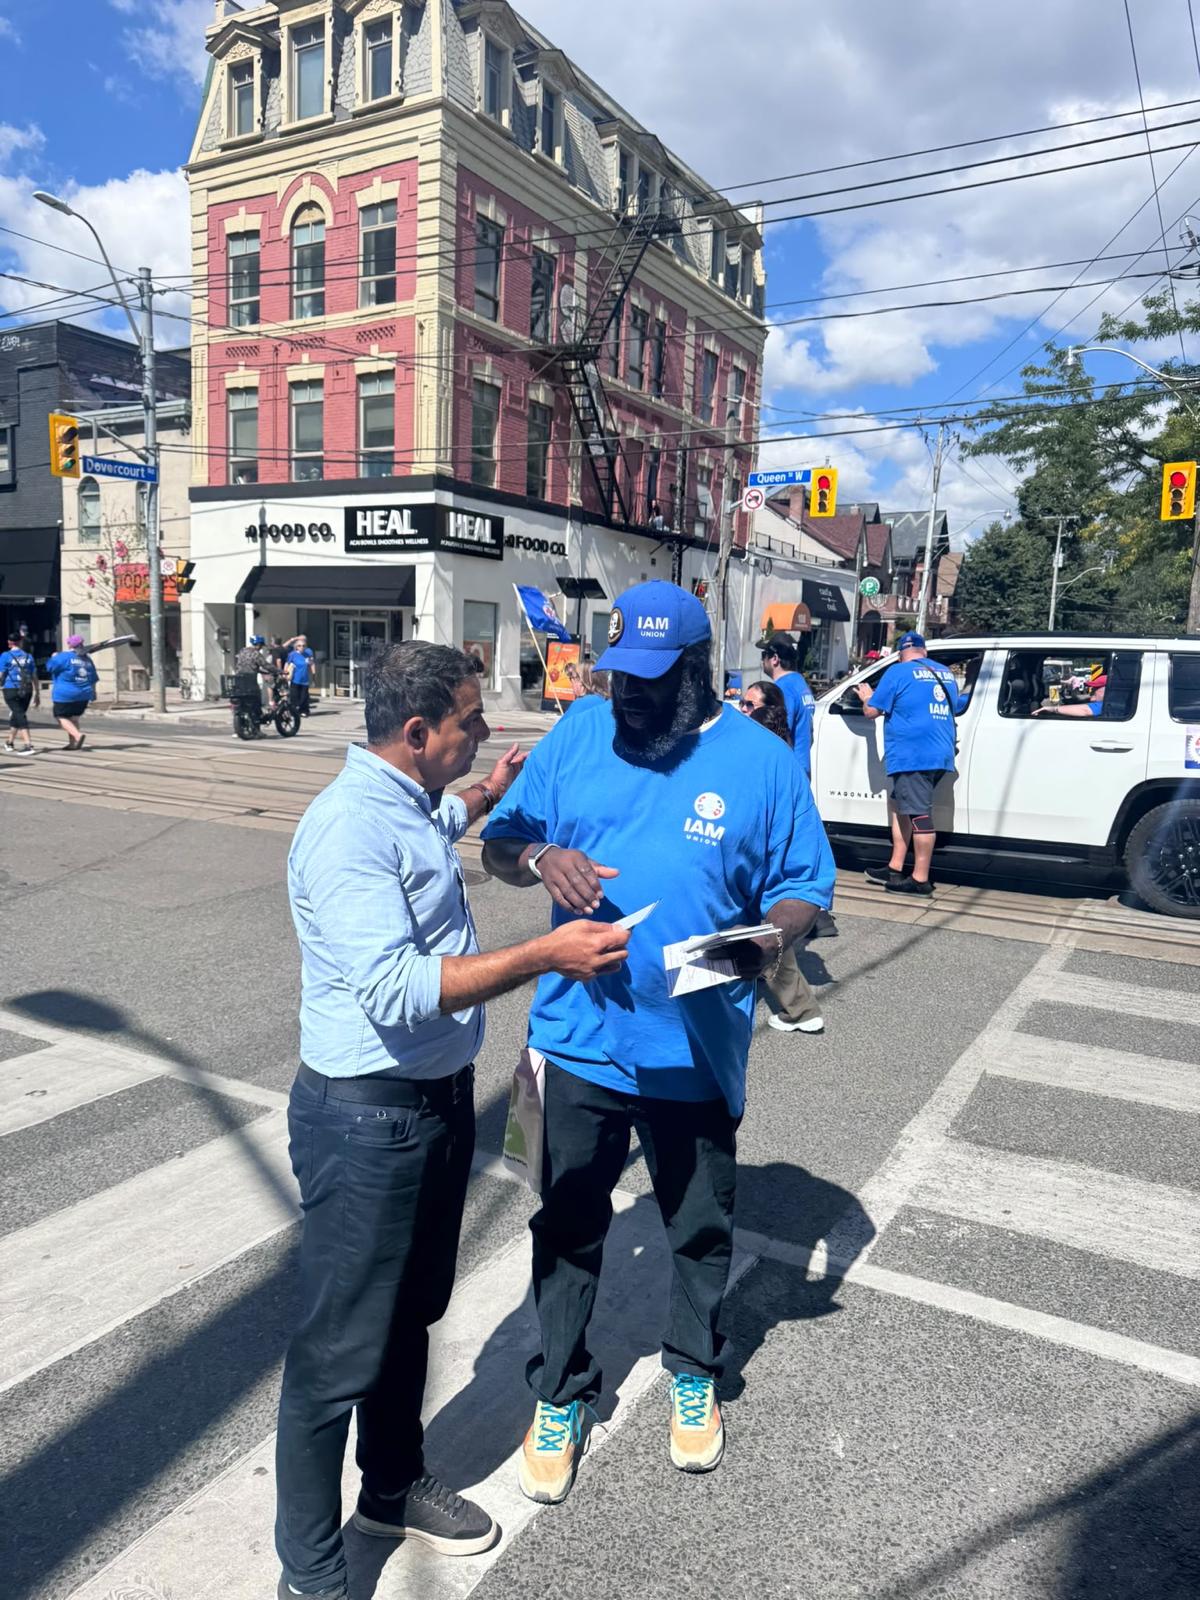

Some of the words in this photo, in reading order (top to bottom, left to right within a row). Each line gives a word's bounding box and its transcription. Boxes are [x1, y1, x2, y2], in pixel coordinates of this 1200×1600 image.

[86, 458, 145, 478] Dovercourt
[757, 473, 786, 484] Queen
[795, 471, 803, 481] W
[259, 523, 304, 539] FOOD
[449, 511, 496, 544] HEAL
[516, 535, 549, 553] FOOD
[637, 615, 669, 630] IAM
[640, 630, 665, 638] UNION
[929, 702, 950, 716] IAM
[683, 817, 726, 841] IAM
[686, 834, 718, 847] UNION
